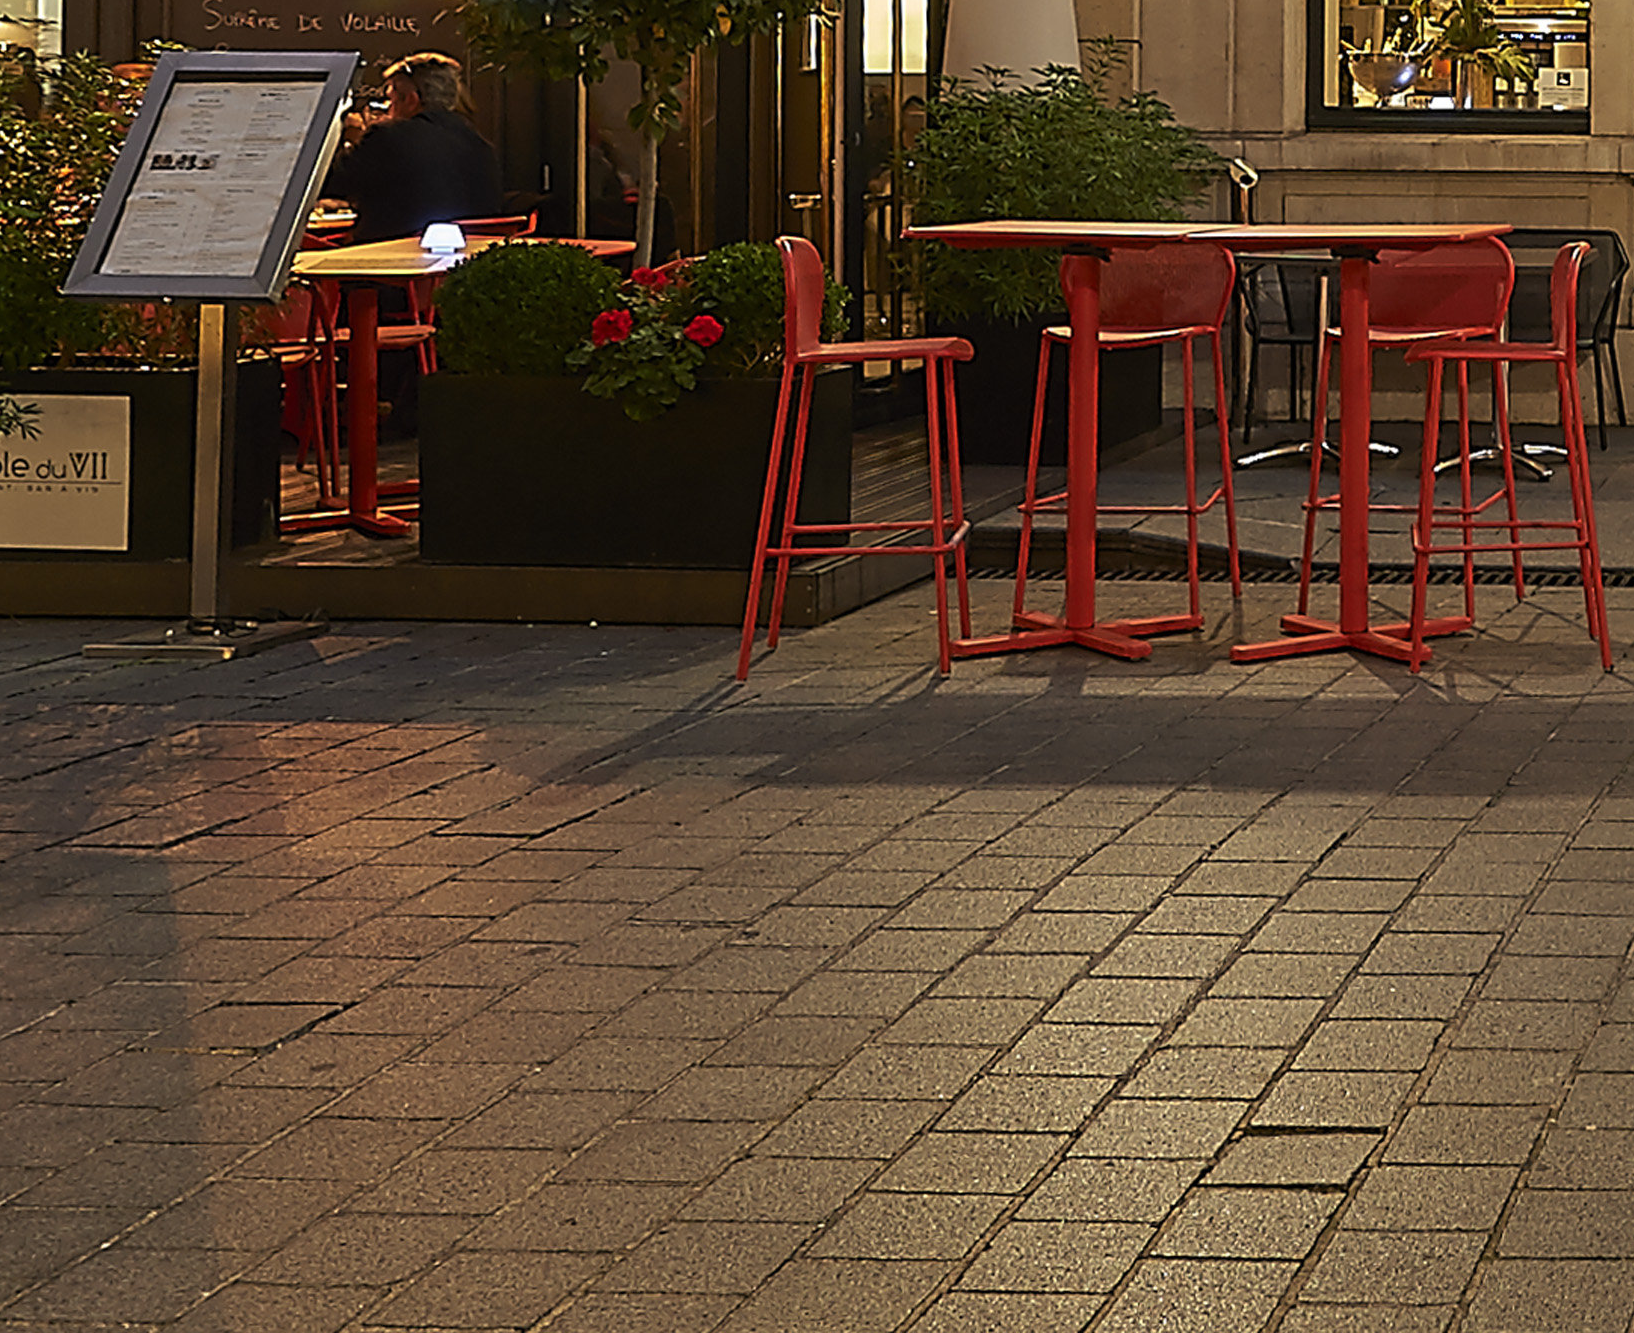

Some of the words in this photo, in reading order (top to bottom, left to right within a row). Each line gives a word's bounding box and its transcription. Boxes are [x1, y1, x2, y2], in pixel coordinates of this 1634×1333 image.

[297, 13, 324, 33] DE
[36, 459, 67, 479] du
[68, 452, 108, 480] VII
